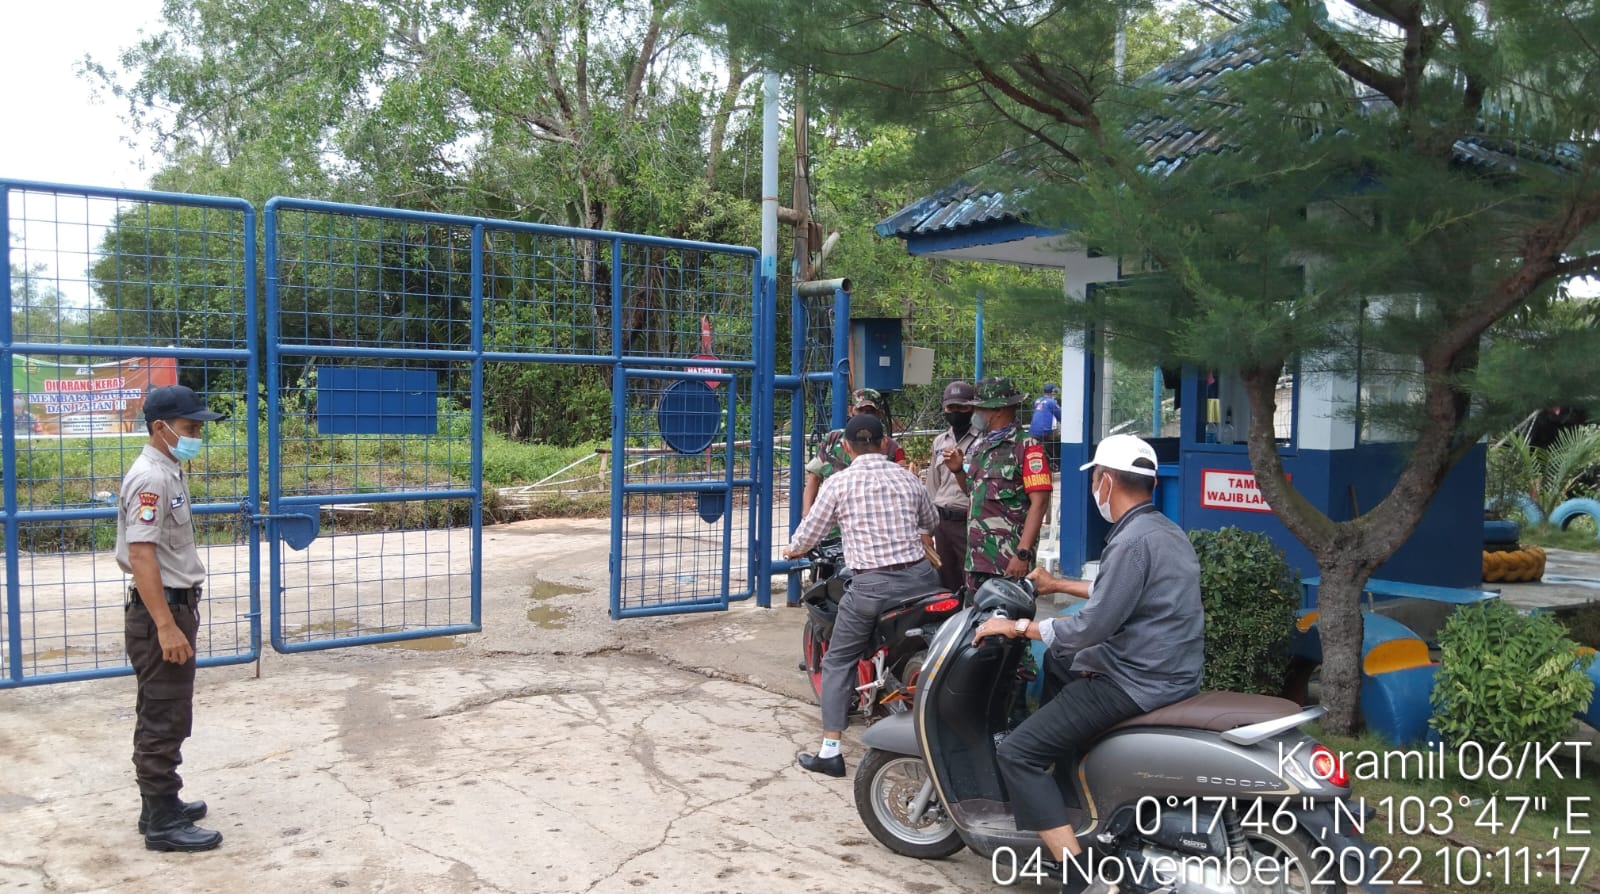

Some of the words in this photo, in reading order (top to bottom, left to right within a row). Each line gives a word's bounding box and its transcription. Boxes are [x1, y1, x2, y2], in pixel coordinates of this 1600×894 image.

[95, 377, 125, 390] KERAS
[46, 404, 72, 413] DAN
[1207, 491, 1244, 503] WAJIB
[1196, 775, 1281, 789] SCOOPY
